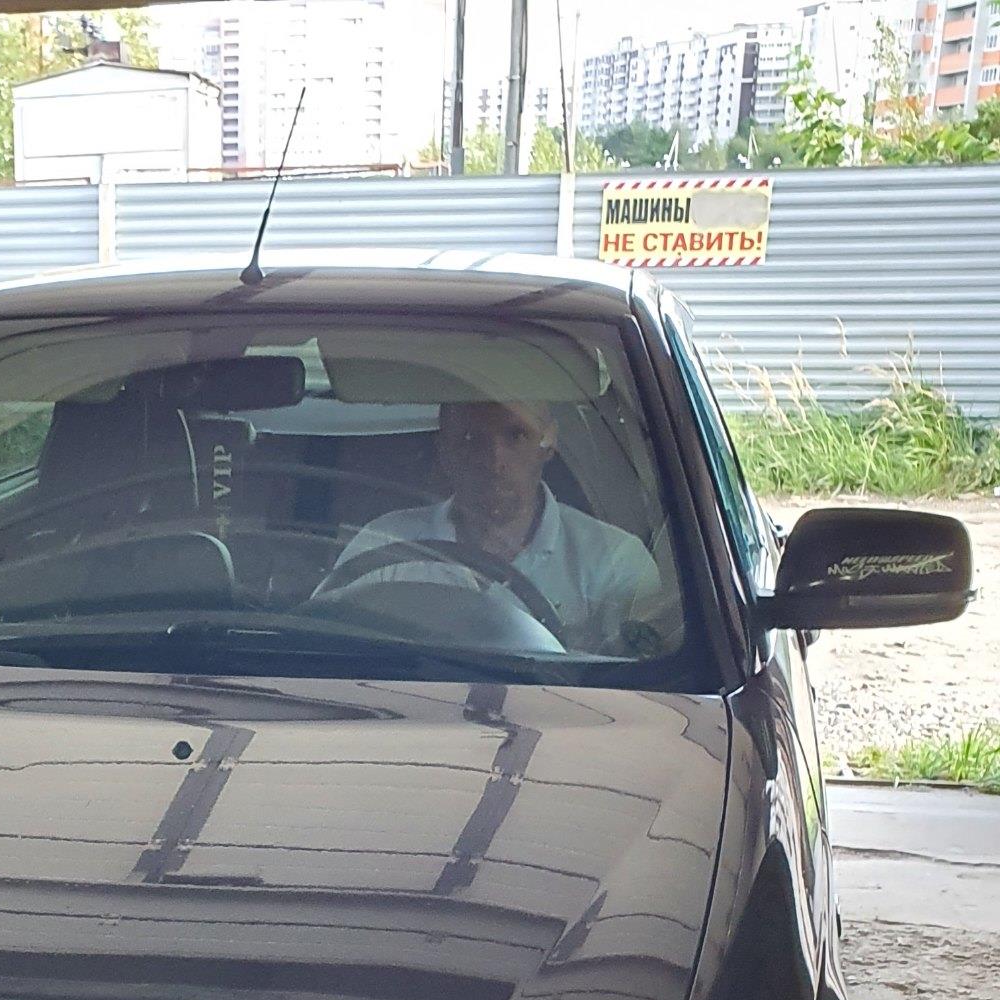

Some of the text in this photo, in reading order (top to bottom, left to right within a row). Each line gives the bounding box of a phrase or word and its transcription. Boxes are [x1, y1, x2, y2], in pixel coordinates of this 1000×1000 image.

[606, 197, 691, 225] МАШИНЫ
[603, 231, 763, 252] НЕ СТАВИТЬ!
[213, 444, 232, 499] VIP
